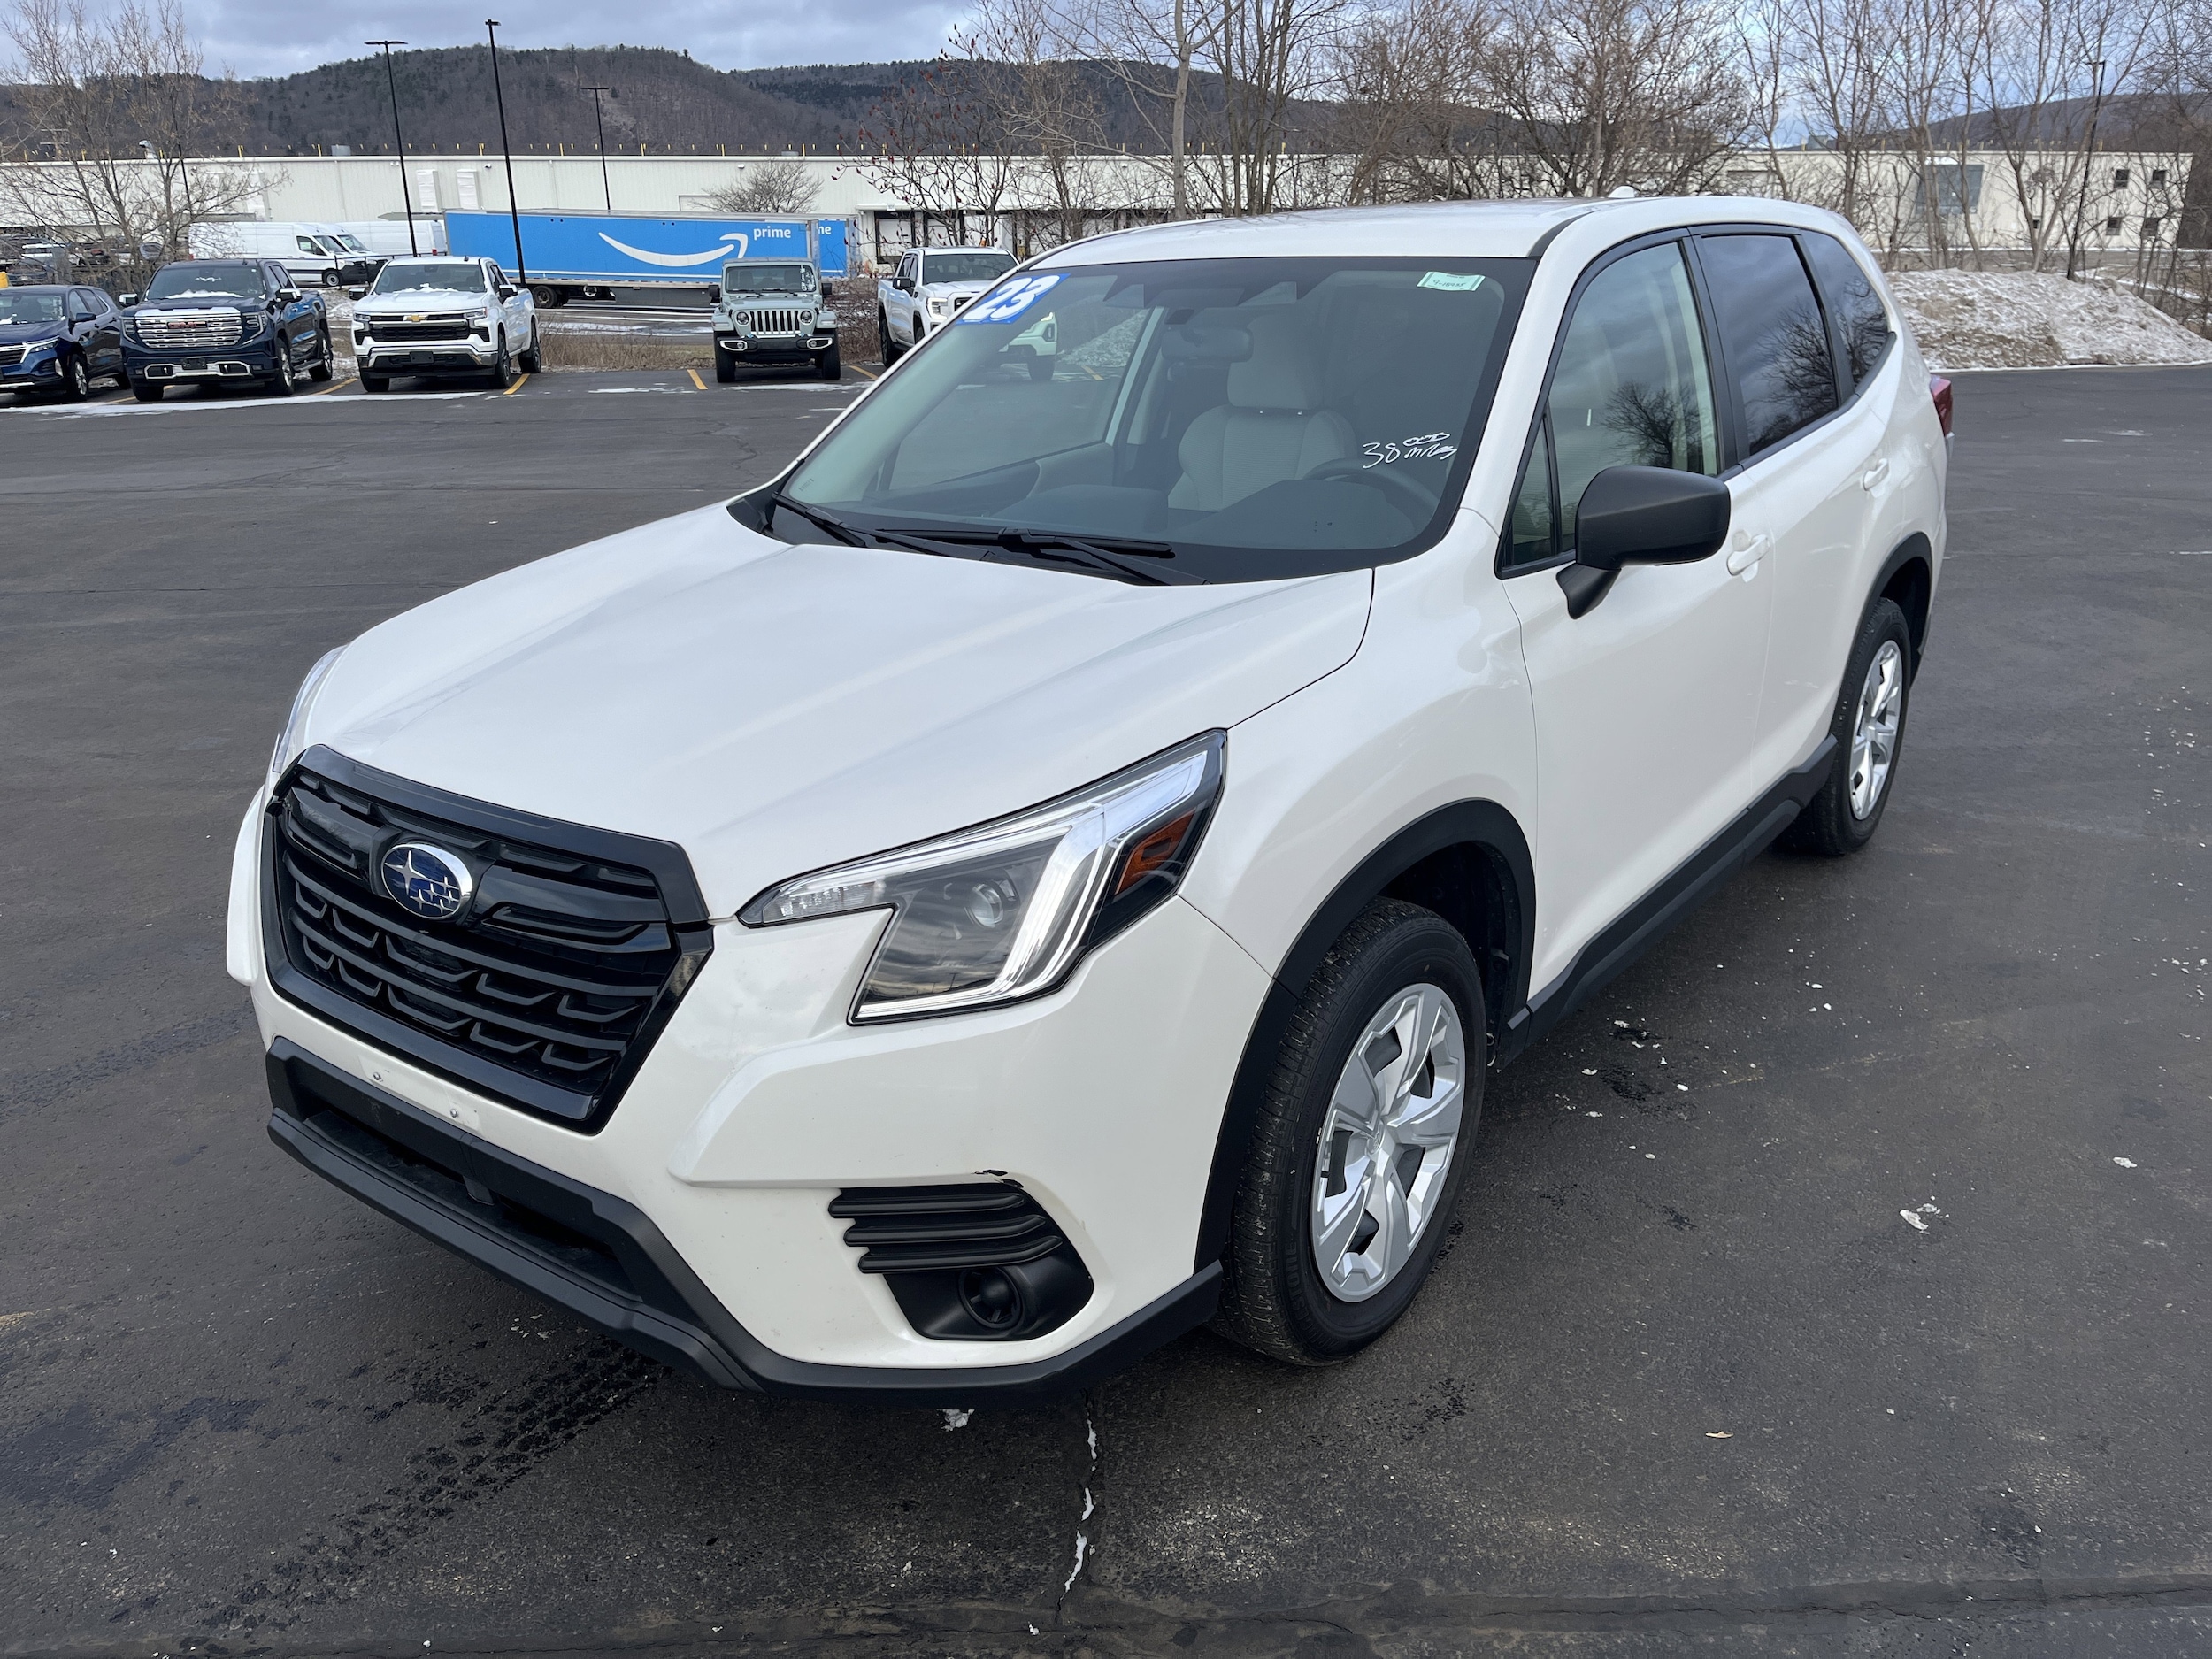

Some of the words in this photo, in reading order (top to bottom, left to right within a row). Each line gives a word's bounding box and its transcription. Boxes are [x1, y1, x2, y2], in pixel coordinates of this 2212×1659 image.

[753, 226, 791, 241] prime
[962, 274, 1061, 323] 23
[1363, 442, 1401, 469] 38
